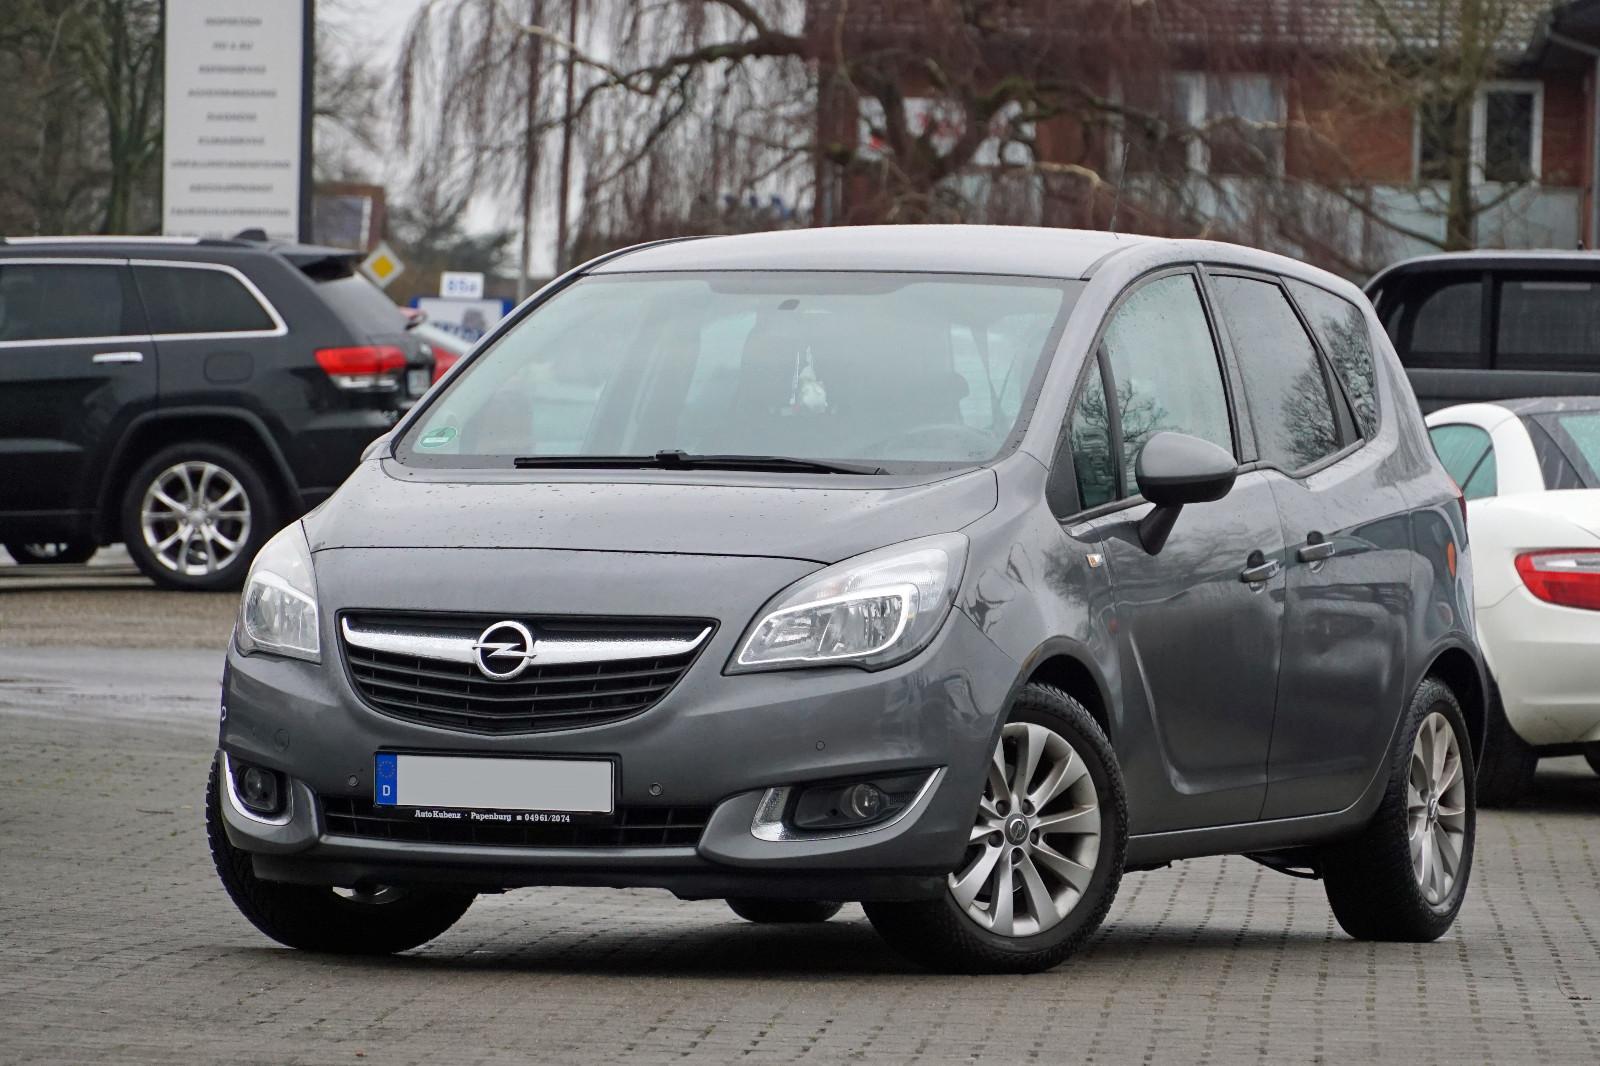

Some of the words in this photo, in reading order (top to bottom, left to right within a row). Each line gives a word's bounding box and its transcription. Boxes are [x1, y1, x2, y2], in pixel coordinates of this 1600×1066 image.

[383, 785, 390, 796] D
[470, 811, 512, 821] Papenburg
[524, 813, 570, 823] 04961/2074
